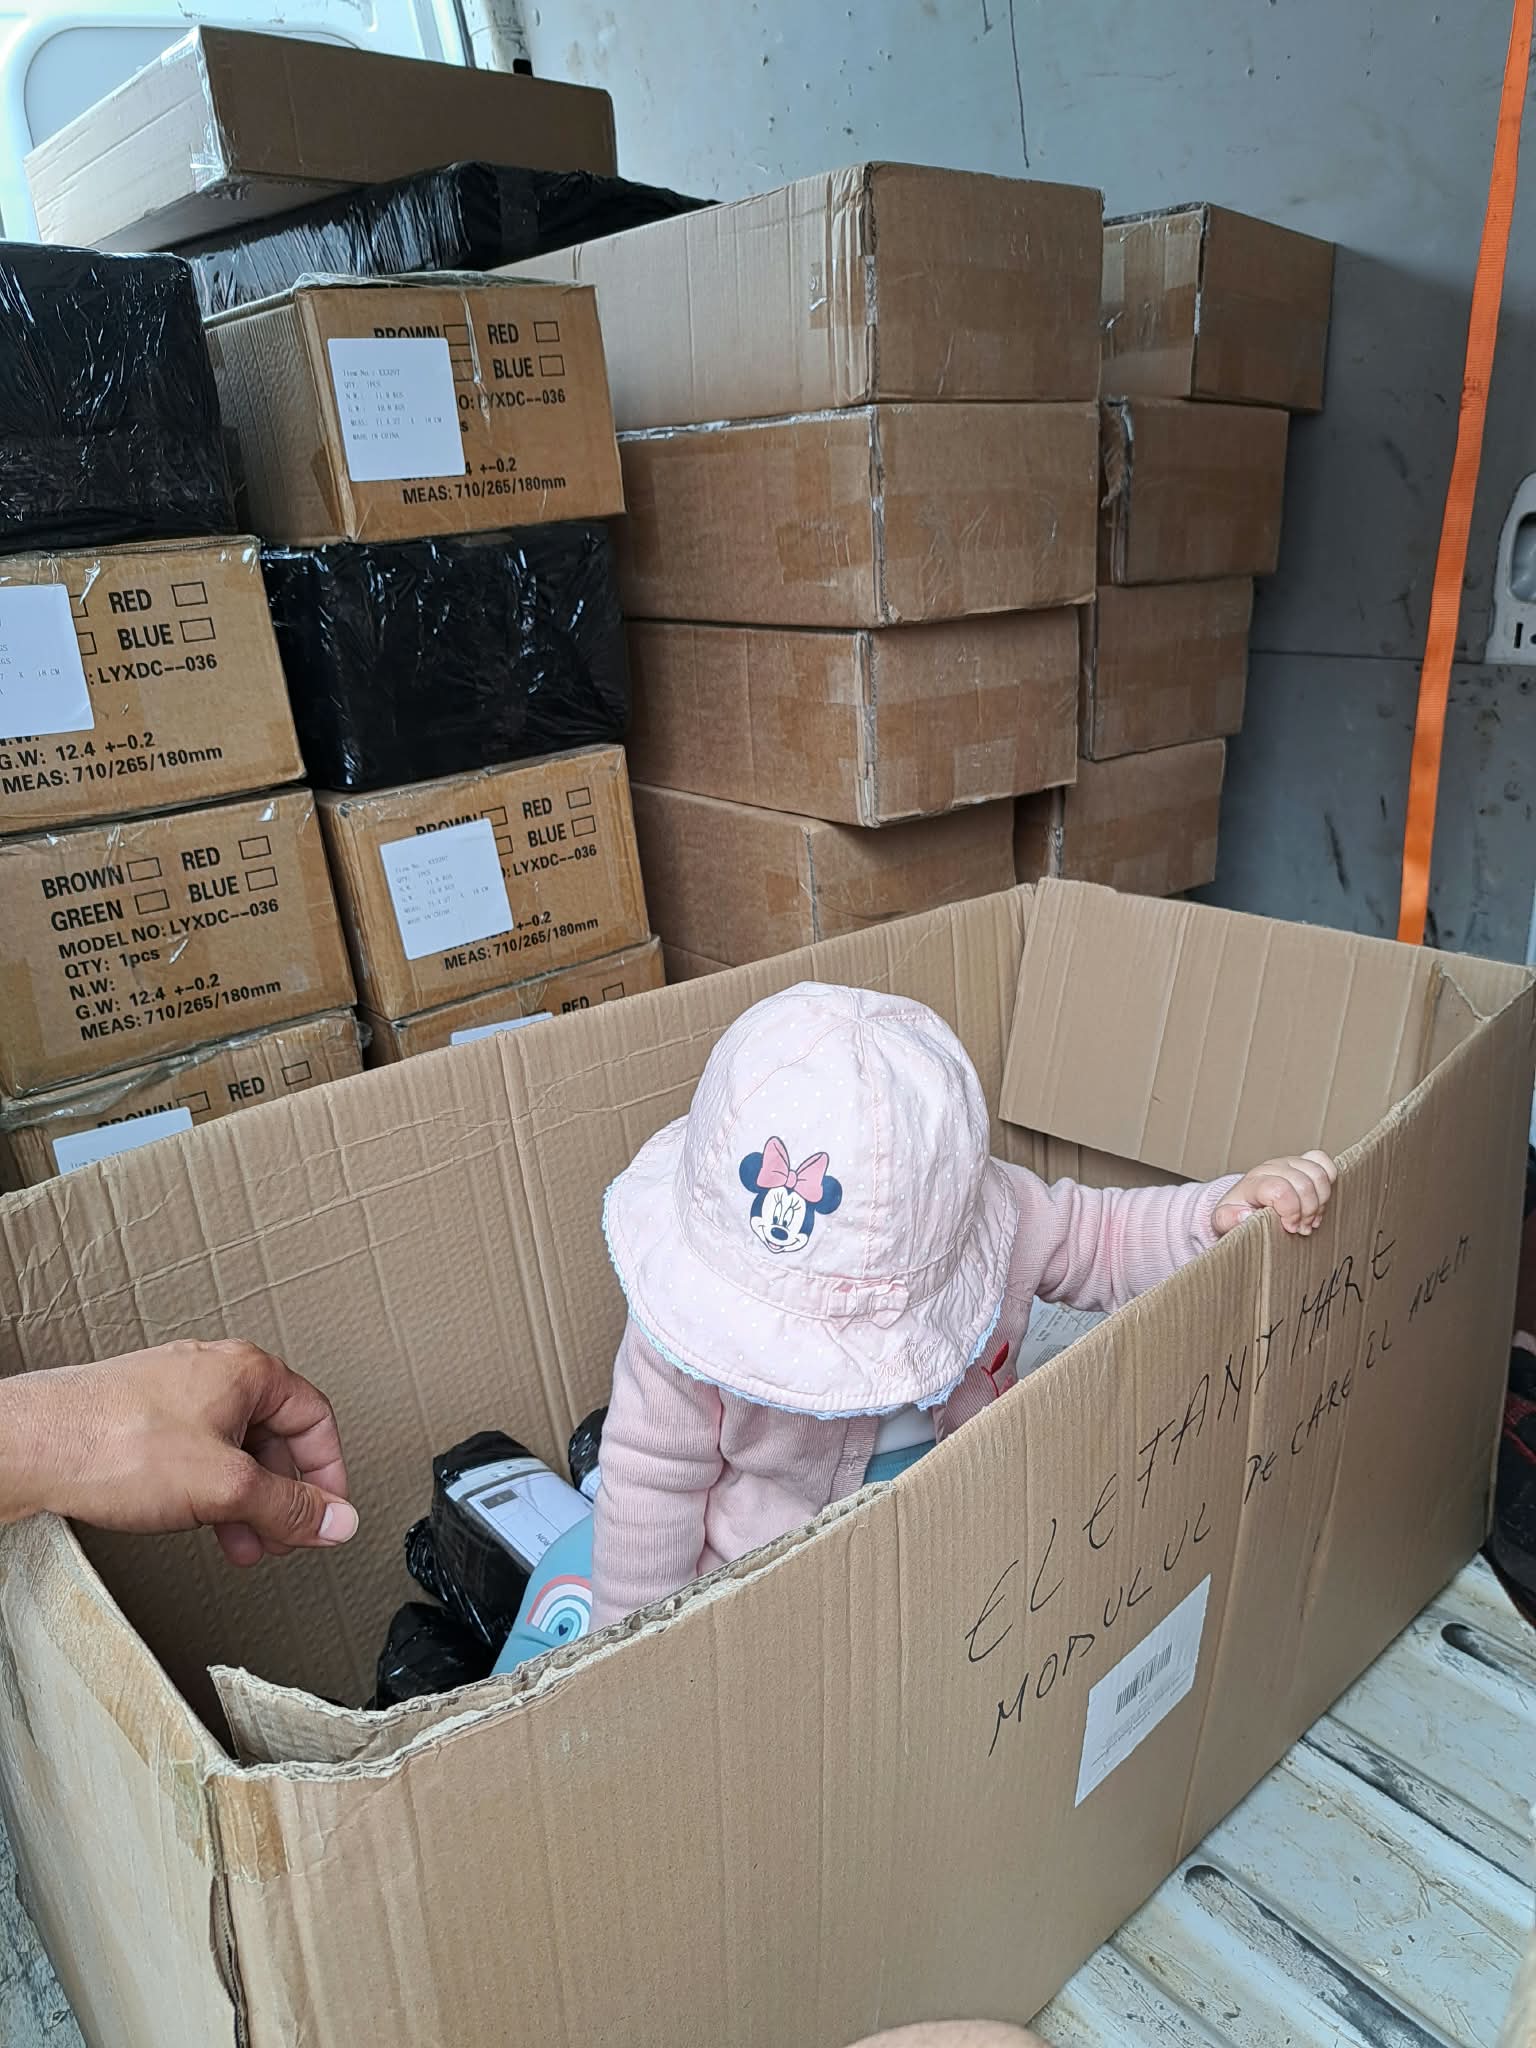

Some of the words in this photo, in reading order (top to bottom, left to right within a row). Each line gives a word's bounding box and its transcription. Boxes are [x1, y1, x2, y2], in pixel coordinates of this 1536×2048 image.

[487, 323, 519, 345] RED
[493, 357, 535, 379] BLUE
[402, 484, 453, 505] MEAS:
[455, 475, 566, 499] 710/265/180mm
[109, 588, 152, 614] RED
[117, 624, 174, 650] BLUE
[98, 653, 218, 684] LYXDC--036
[56, 741, 96, 762] 12.4
[2, 769, 70, 795] MEAS:
[74, 746, 223, 783] 710/265/180mm
[522, 797, 553, 819] RED
[527, 823, 567, 848] BLUE
[42, 865, 125, 900] BROWN
[181, 846, 221, 873] RED
[51, 899, 124, 933] GREEN
[188, 876, 239, 904] BLUE
[58, 932, 129, 960] MODEL
[131, 924, 167, 944] NO:
[169, 899, 280, 936] LYXDC--036
[444, 946, 492, 971] MEAS:
[493, 917, 599, 957] 710/265/180mm
[64, 958, 110, 980] QTY:
[118, 948, 161, 970] 1pcs
[70, 979, 116, 1001] N.W:
[75, 1000, 120, 1022] G.W:
[129, 989, 166, 1009] 12.4
[80, 1015, 142, 1042] MEAS:
[144, 979, 282, 1026] 710/265/180mm
[227, 1076, 265, 1102] RED
[1291, 1367, 1352, 1456] CARE
[965, 1318, 1284, 1663] ELEFANT
[1290, 1230, 1396, 1367] MARE
